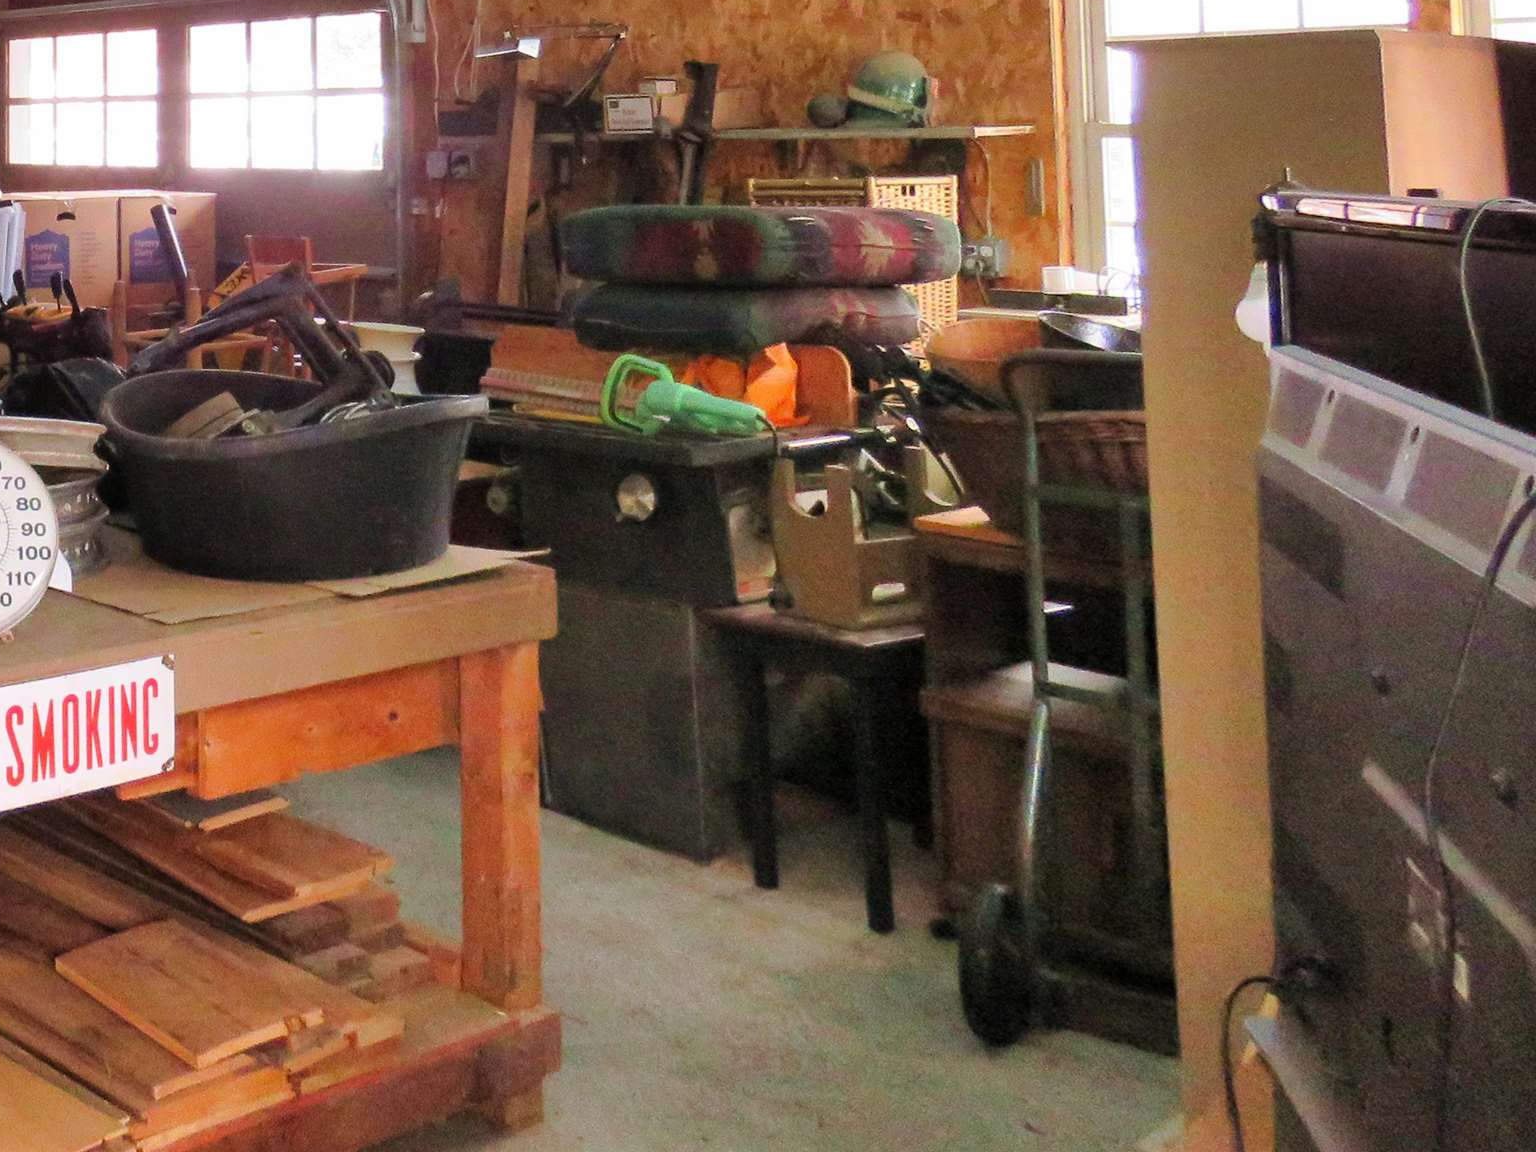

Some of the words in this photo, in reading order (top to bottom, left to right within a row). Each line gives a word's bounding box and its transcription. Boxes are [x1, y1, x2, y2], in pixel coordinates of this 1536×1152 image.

[0, 476, 26, 490] 70
[16, 497, 42, 511] 80
[21, 522, 47, 536] 90
[16, 546, 52, 560] 100
[6, 571, 37, 586] 110
[4, 677, 160, 788] SMOKING
